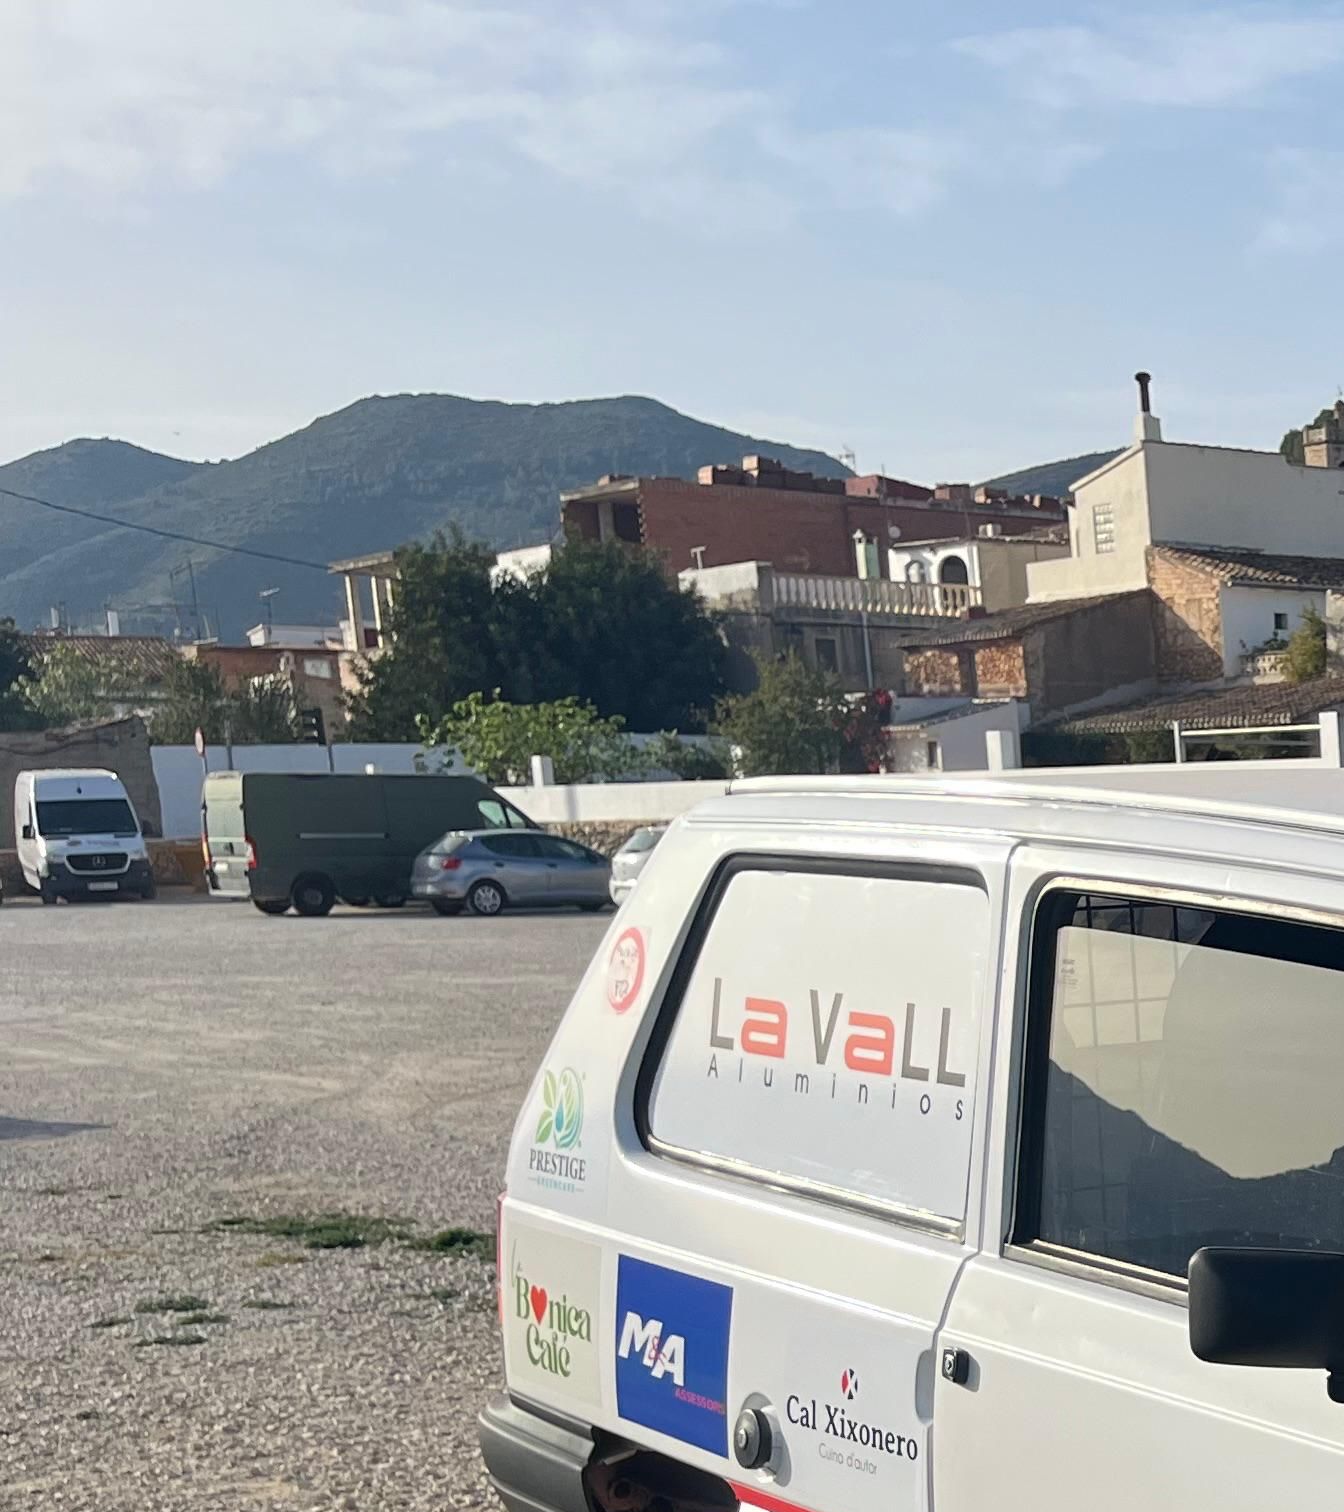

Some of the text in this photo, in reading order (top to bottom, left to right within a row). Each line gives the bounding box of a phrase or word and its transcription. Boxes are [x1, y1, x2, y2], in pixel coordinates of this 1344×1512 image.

[707, 1053, 964, 1121] Aluminios
[528, 1149, 586, 1182] PRESTIGE
[526, 1323, 571, 1378] Café
[786, 1394, 918, 1461] Cal Xixonero
